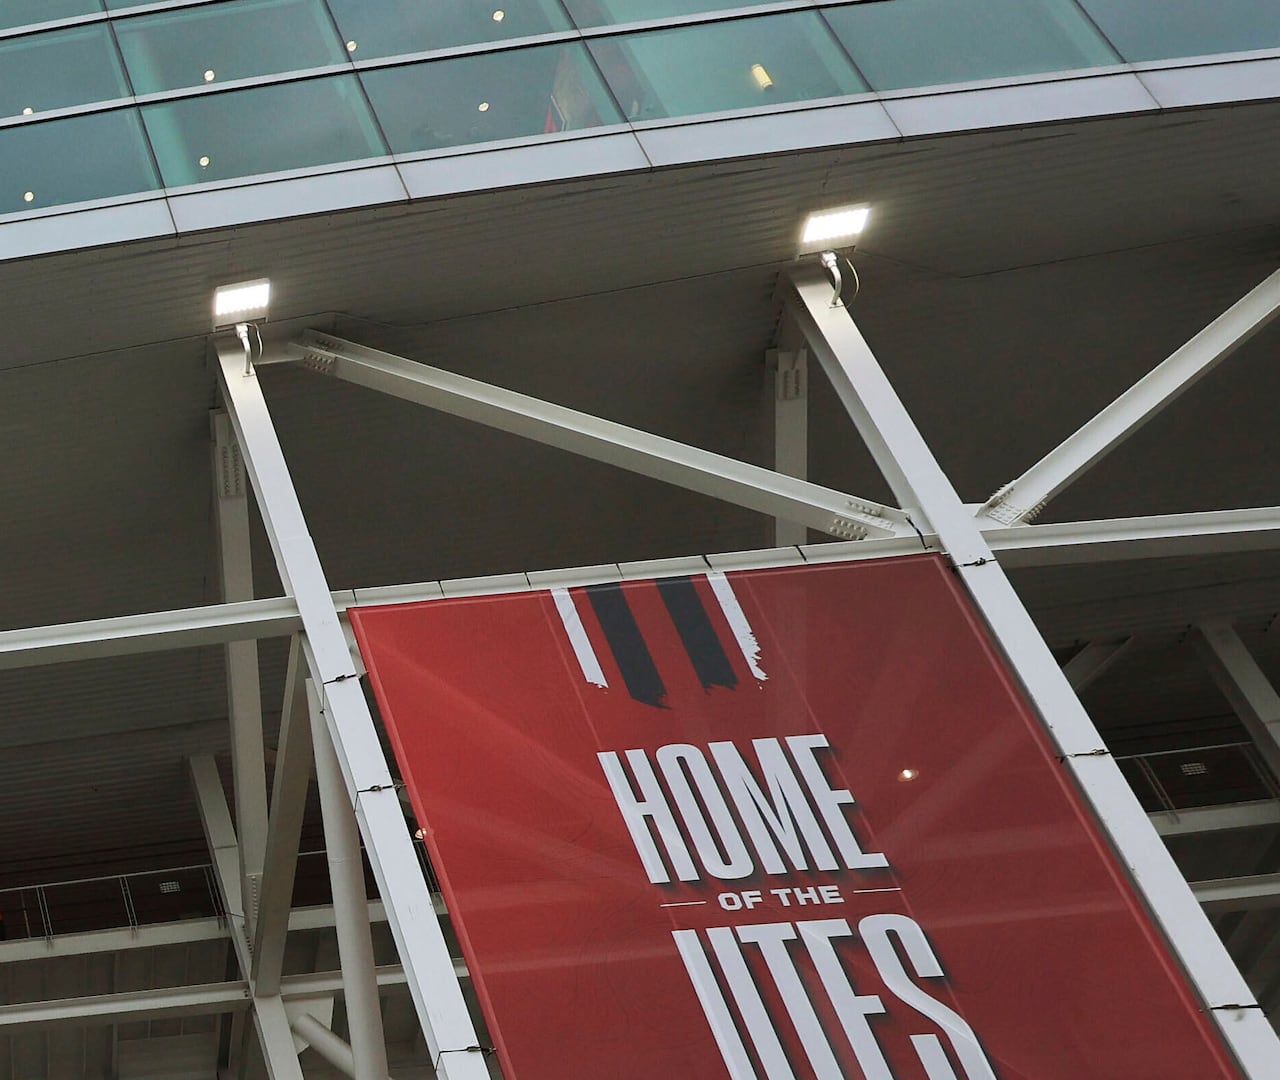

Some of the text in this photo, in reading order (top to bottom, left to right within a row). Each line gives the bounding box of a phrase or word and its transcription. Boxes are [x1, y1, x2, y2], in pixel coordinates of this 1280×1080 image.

[597, 733, 888, 884] HOME
[718, 886, 844, 911] OF THE
